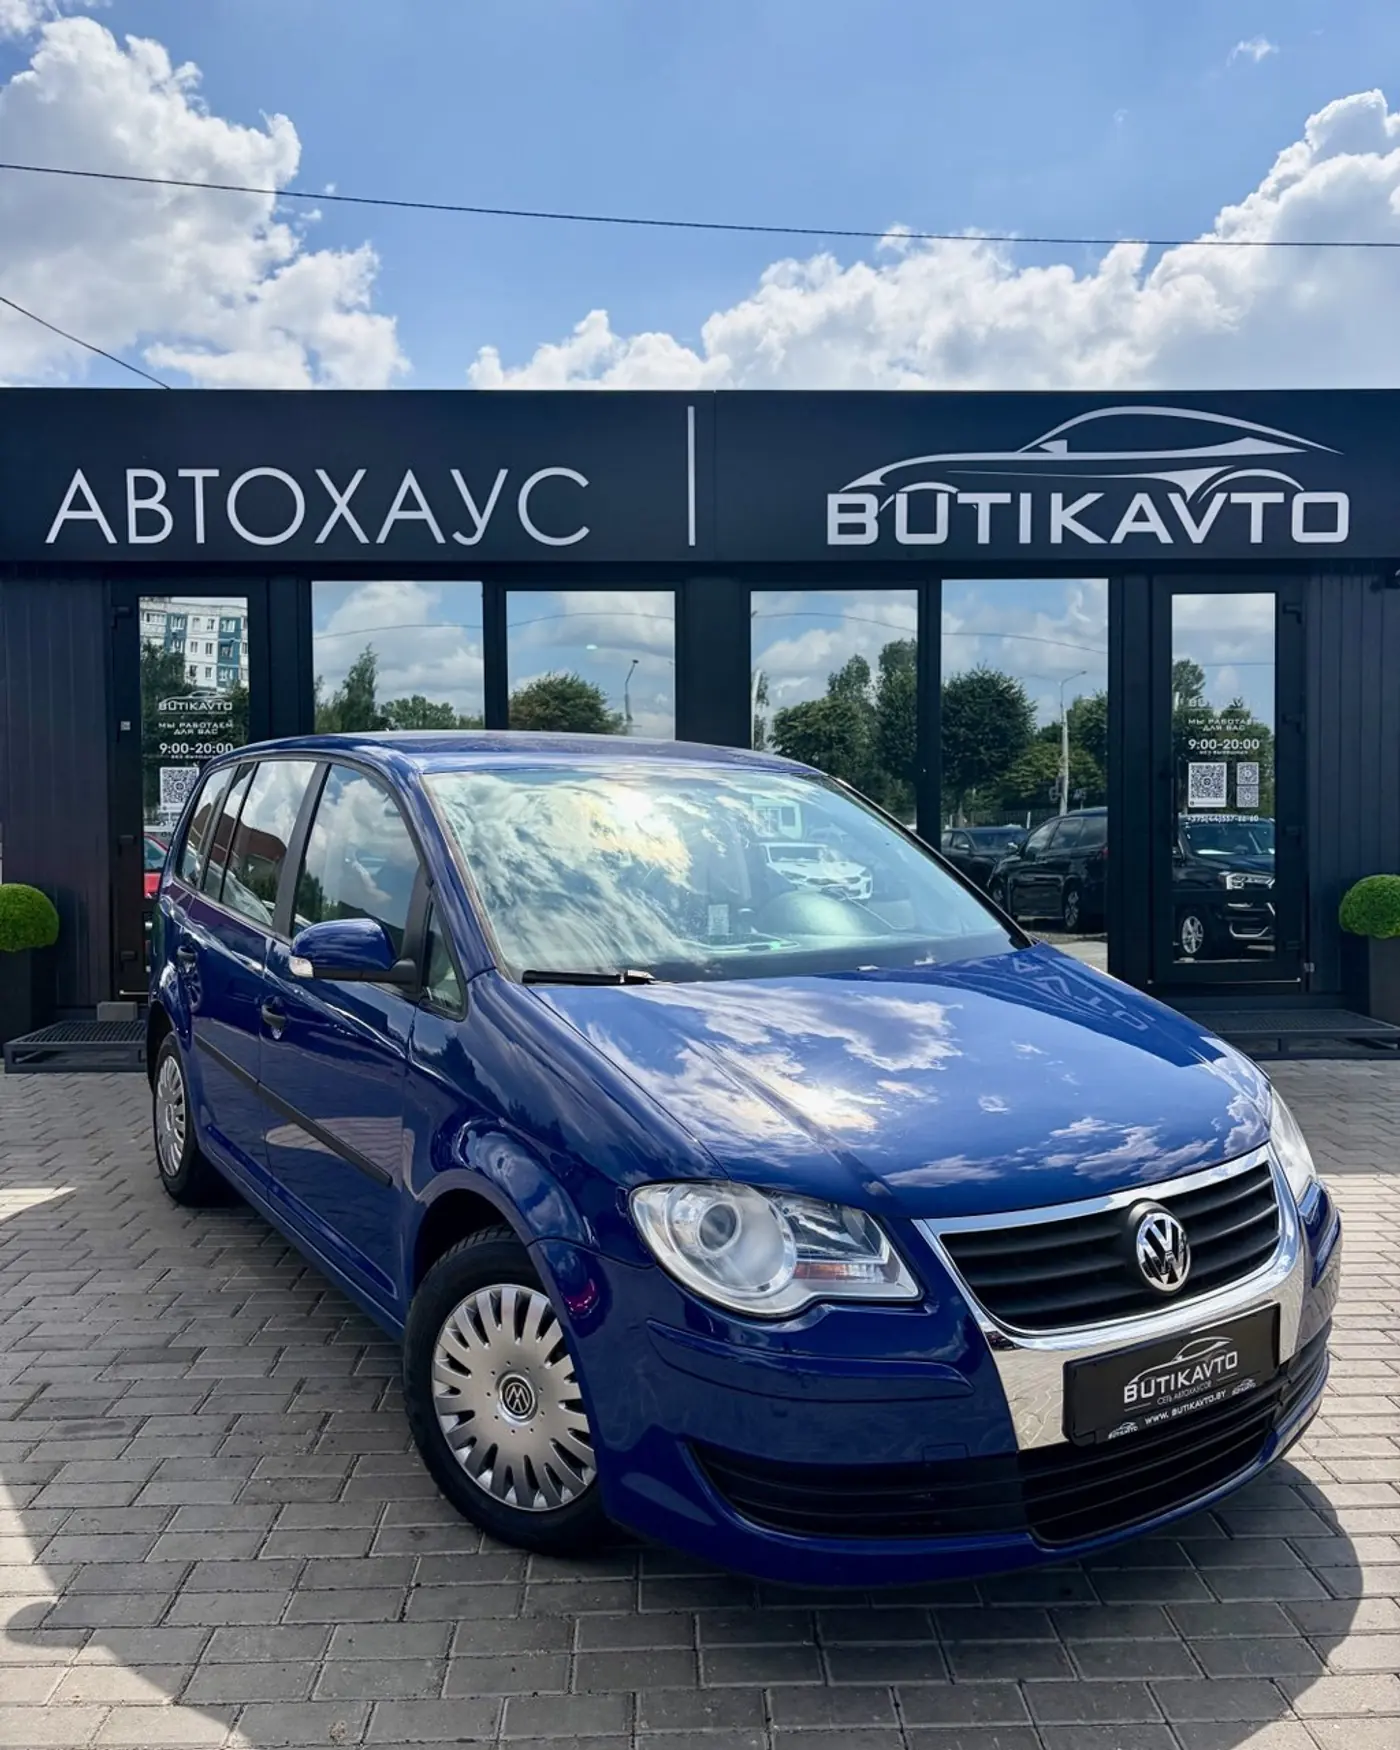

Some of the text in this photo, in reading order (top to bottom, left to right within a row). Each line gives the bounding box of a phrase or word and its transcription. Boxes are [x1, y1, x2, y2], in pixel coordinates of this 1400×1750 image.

[45, 467, 591, 546] АВТОХАУС
[826, 491, 1350, 546] BUTIKAVTO
[158, 701, 233, 711] BUTIKAVTO
[159, 743, 234, 755] 9:00-20:00
[1188, 738, 1260, 750] 9:00-20:00
[1123, 1351, 1238, 1404] BUTIKAVTO
